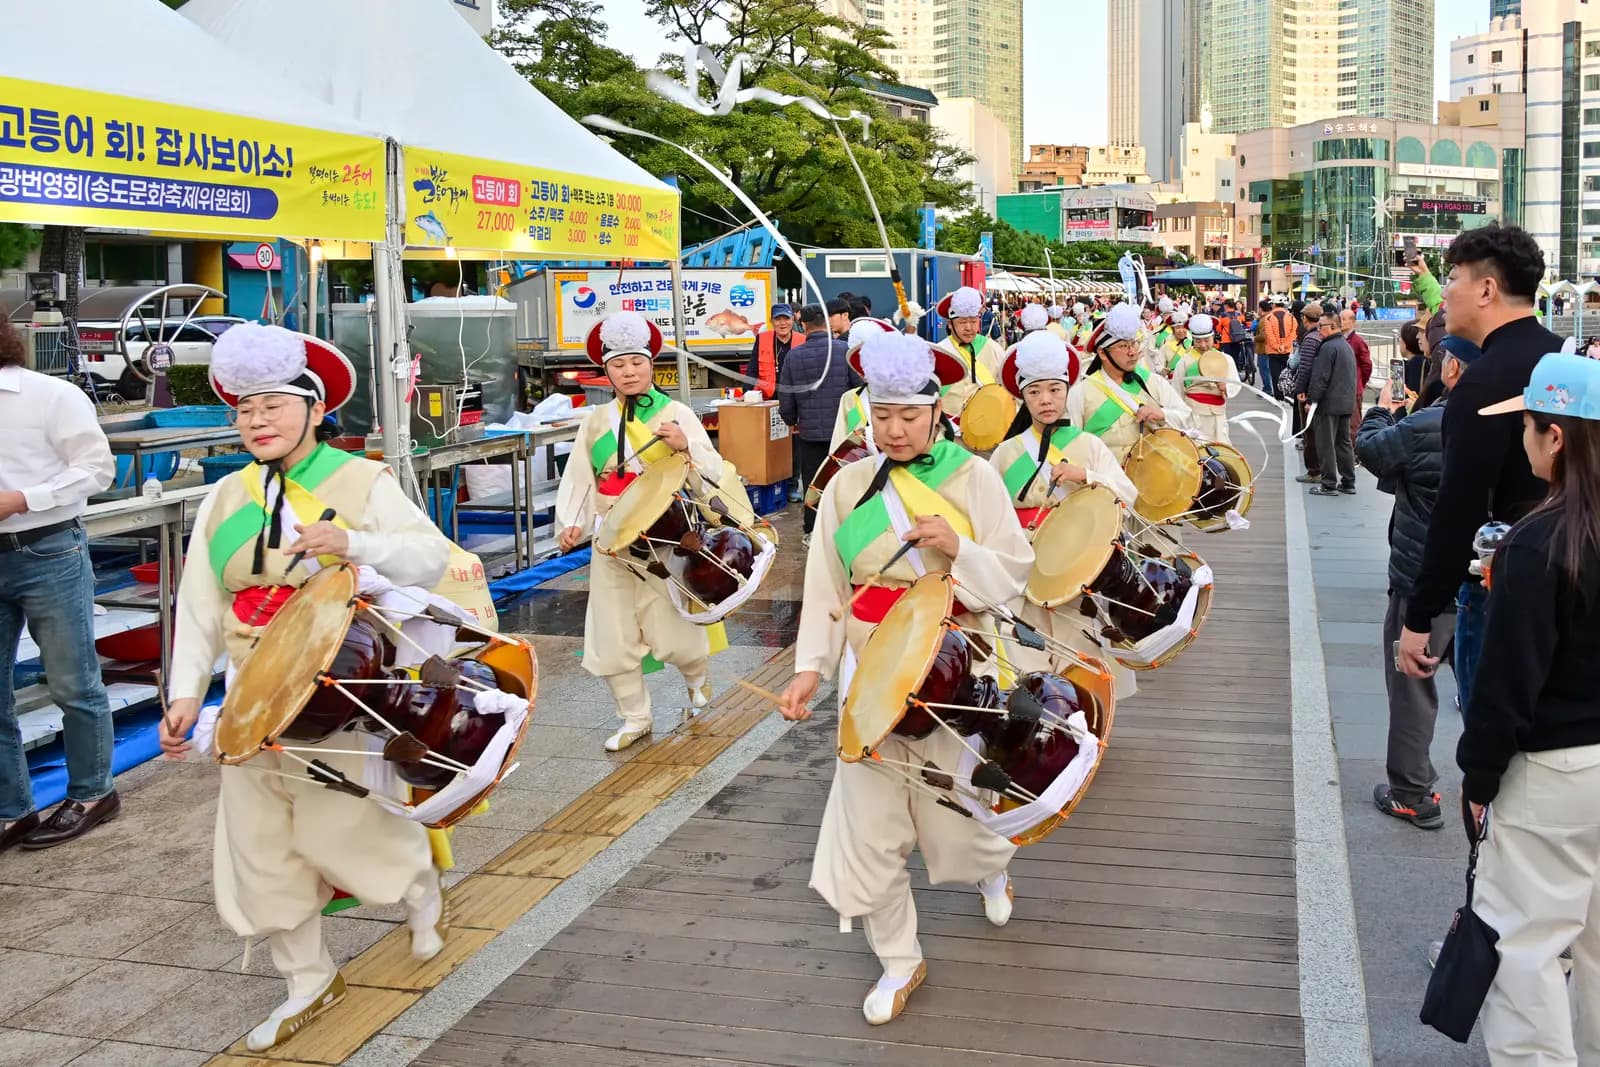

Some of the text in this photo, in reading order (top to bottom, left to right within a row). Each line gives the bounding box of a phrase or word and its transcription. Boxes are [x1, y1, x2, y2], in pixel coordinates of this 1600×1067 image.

[0, 105, 293, 178] 고등어 회! 잡사보이소!
[342, 163, 372, 186] 고등어
[475, 178, 518, 203] 고등어 회
[531, 180, 558, 203] 고등어
[616, 192, 642, 212] 30,000
[529, 205, 564, 223] 소주/맥주
[1445, 203, 1461, 211] ROAD
[477, 210, 515, 232] 27,000
[600, 213, 620, 228] 음료수
[529, 225, 552, 241] 막걸리
[260, 250, 271, 263] 30
[609, 280, 652, 296] 안전하고
[701, 281, 722, 294] 키운
[622, 299, 670, 312] 대한민국
